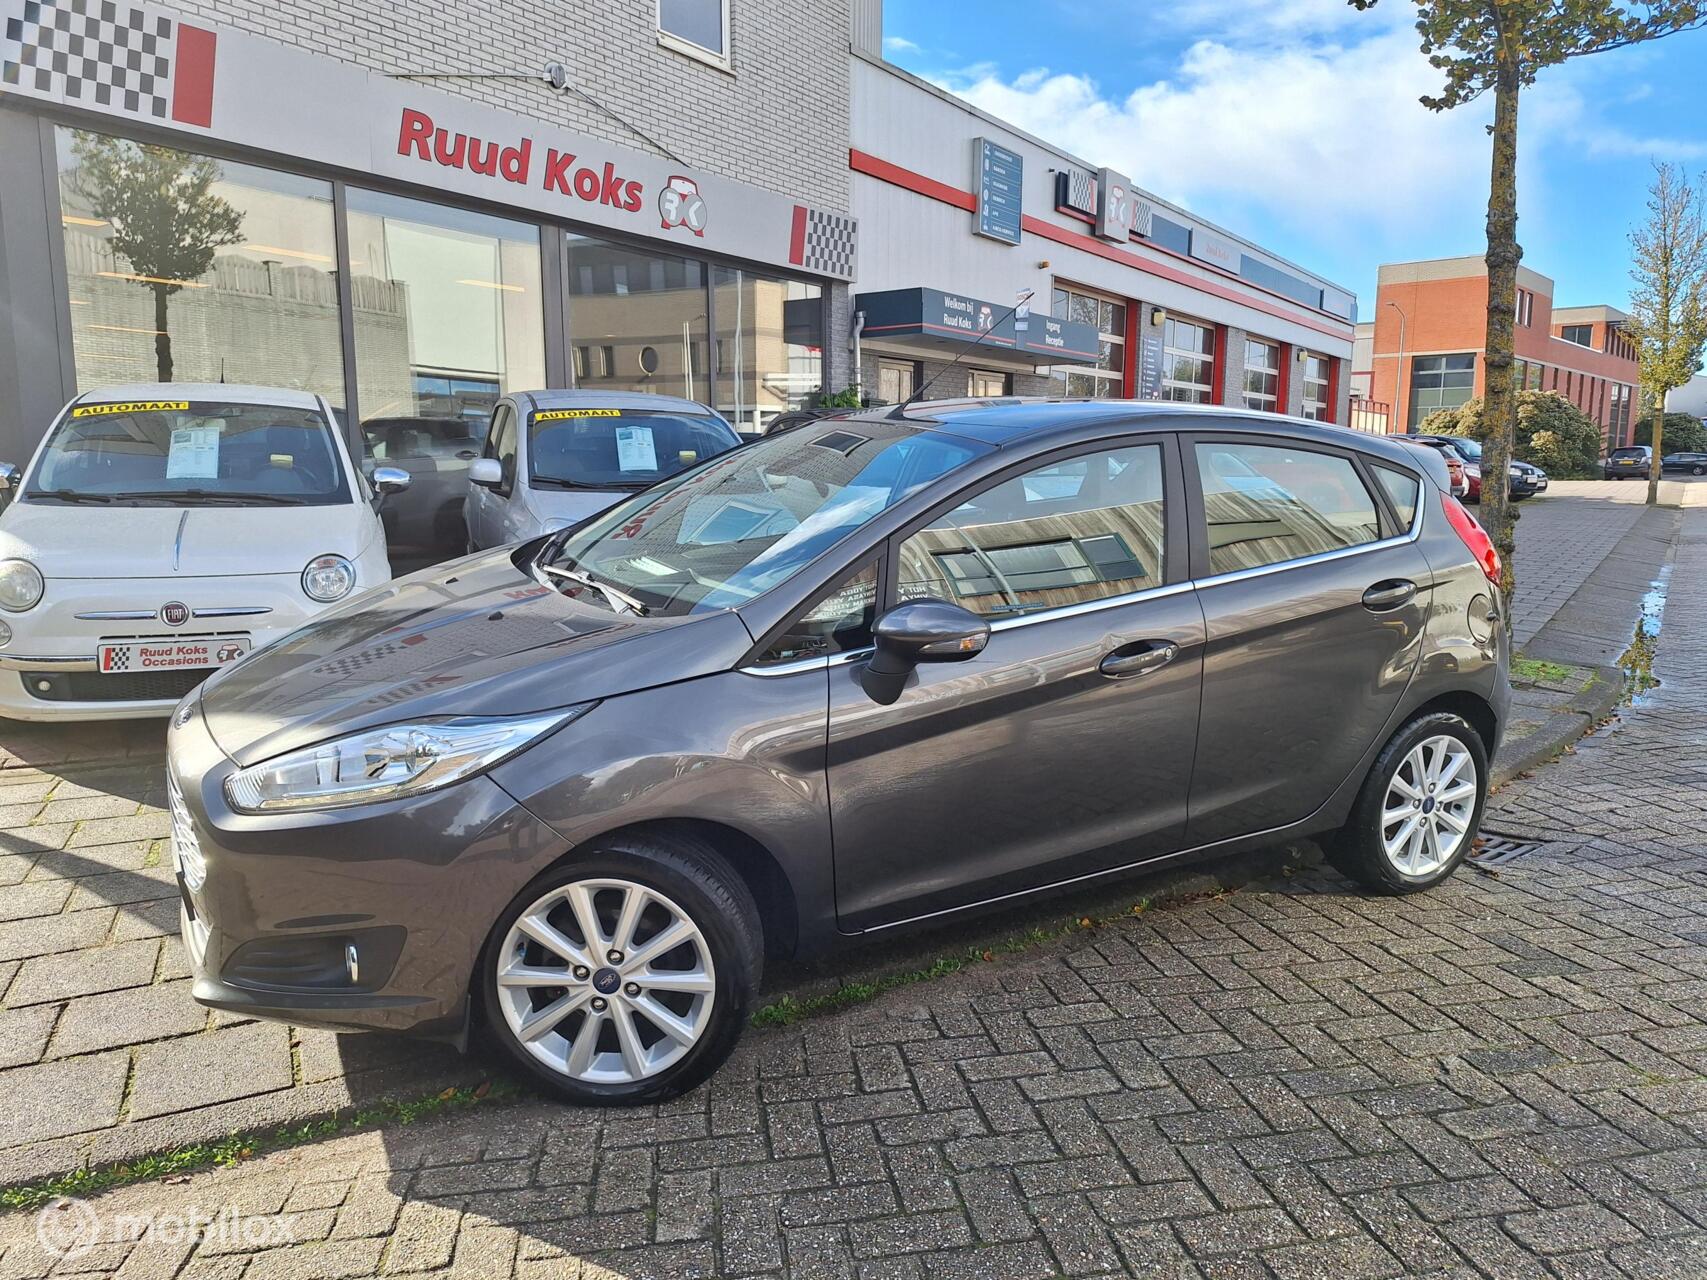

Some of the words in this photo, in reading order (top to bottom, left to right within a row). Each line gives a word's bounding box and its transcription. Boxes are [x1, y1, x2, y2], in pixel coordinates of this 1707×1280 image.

[397, 107, 532, 185] Ruud
[543, 148, 643, 213] Koks
[944, 296, 966, 311] Welkom
[966, 301, 974, 315] bij
[943, 313, 959, 327] Ruud
[958, 316, 972, 329] Koks
[1045, 319, 1061, 334] Ingang
[1045, 334, 1064, 347] Receptie
[79, 401, 185, 416] AUTOMAAT
[540, 410, 615, 420] AUTOMAAT
[167, 609, 184, 620] FIAT
[140, 647, 173, 657] Ruud
[176, 646, 208, 656] Koks
[142, 656, 209, 667] Occasions
